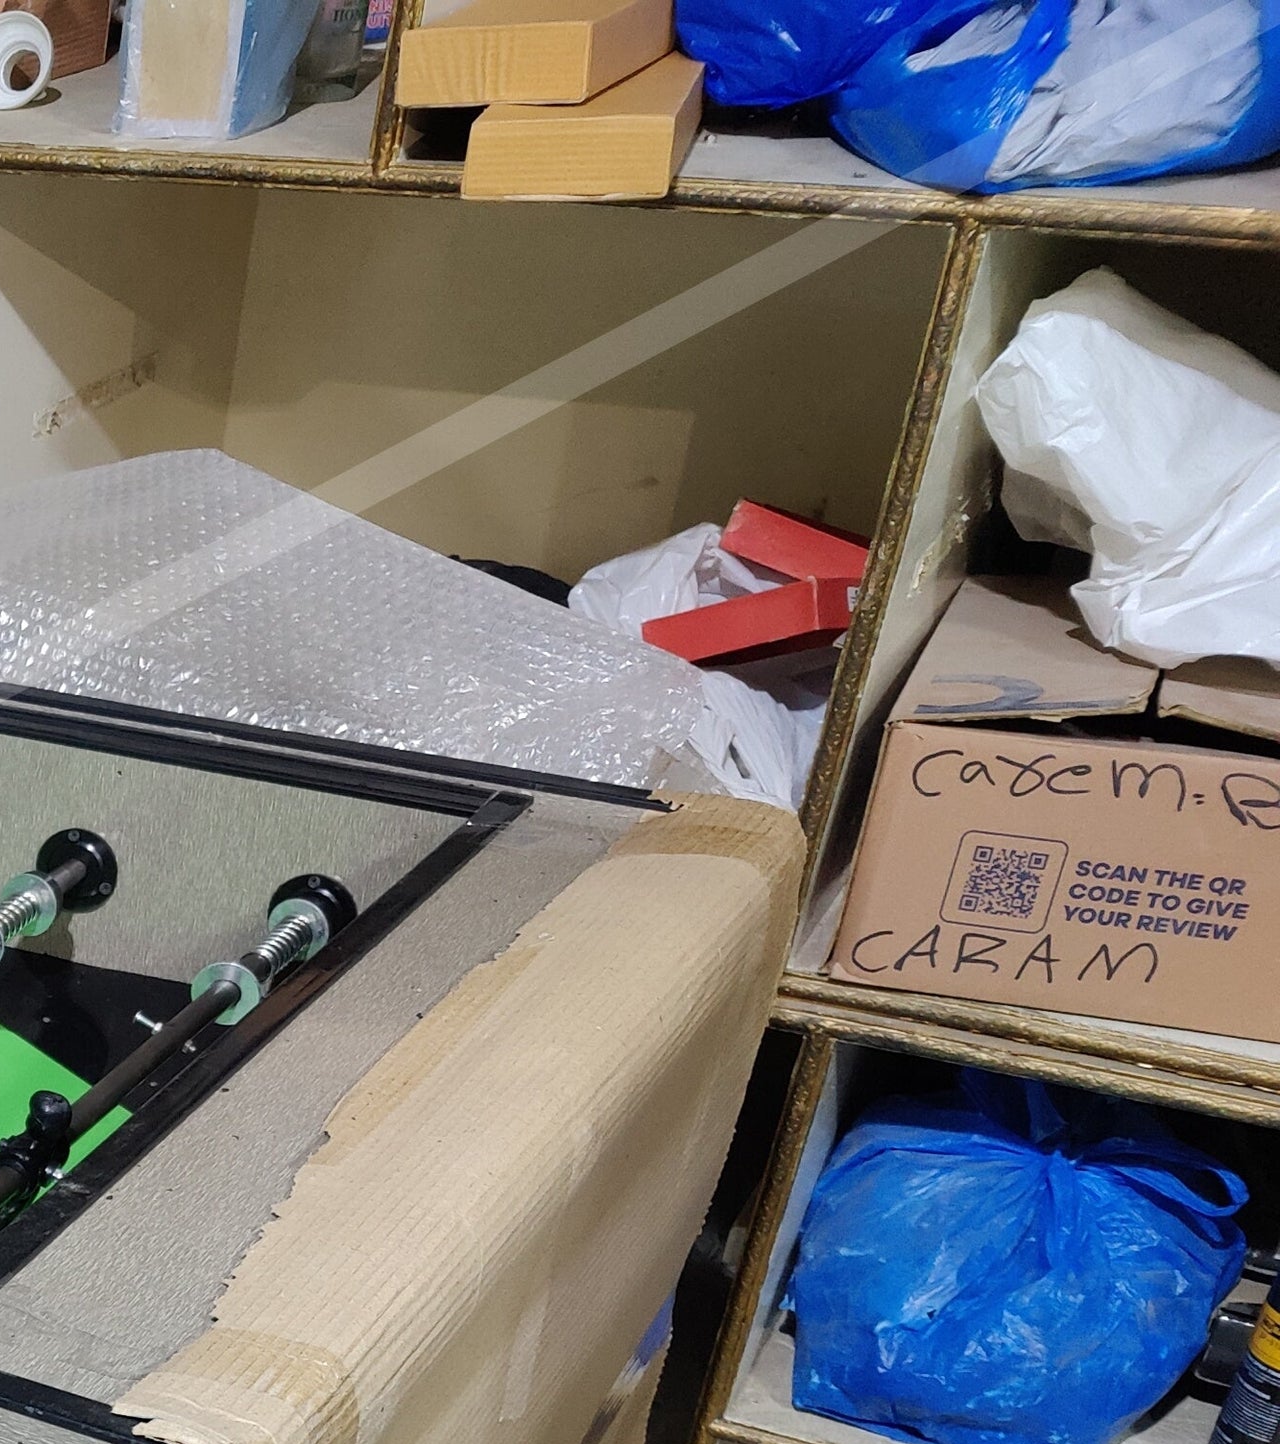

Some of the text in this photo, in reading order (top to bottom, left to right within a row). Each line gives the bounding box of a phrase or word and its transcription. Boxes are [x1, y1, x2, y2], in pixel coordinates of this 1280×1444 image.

[1075, 860, 1247, 897] SCAN THE QR
[1068, 883, 1250, 920] CODE TO GIVE
[1063, 905, 1239, 942] YOUR REVIEW
[851, 925, 1160, 984] CARAM
